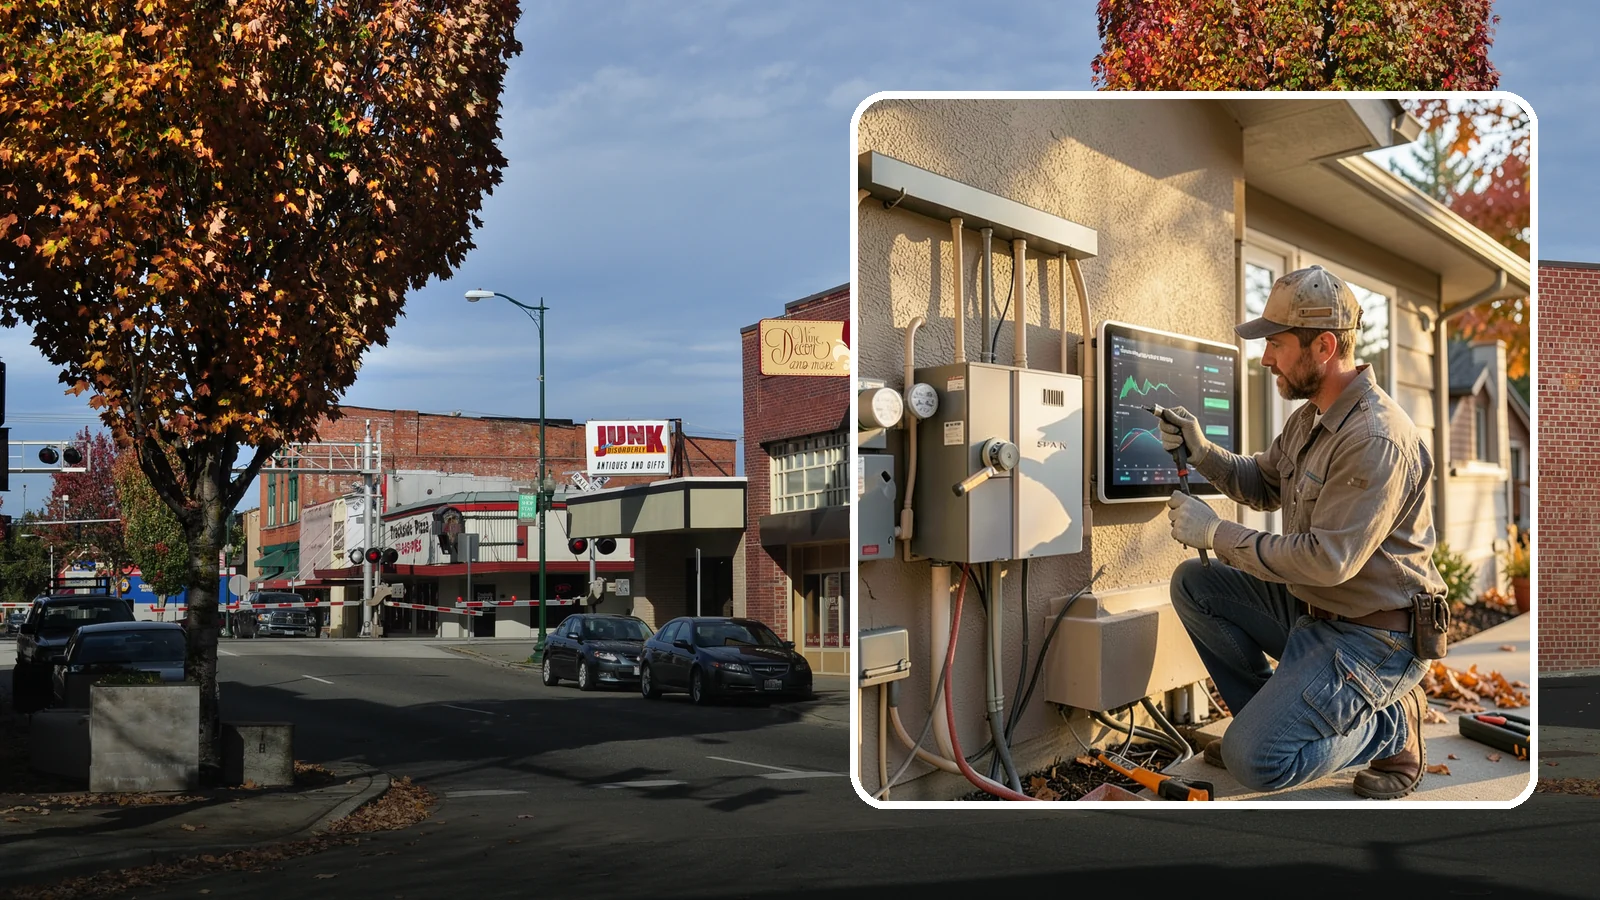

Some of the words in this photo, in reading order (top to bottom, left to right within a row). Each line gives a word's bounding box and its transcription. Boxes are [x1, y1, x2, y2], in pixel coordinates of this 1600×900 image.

[595, 425, 665, 457] JUNK
[607, 446, 646, 454] DISORDERLY
[597, 461, 628, 470] ANTIQUES
[631, 461, 644, 469] AND
[647, 460, 665, 469] GIFTS
[573, 473, 589, 492] RAIL
[590, 476, 608, 492] SING
[352, 498, 365, 511] CRO
[414, 519, 430, 535] Pizza
